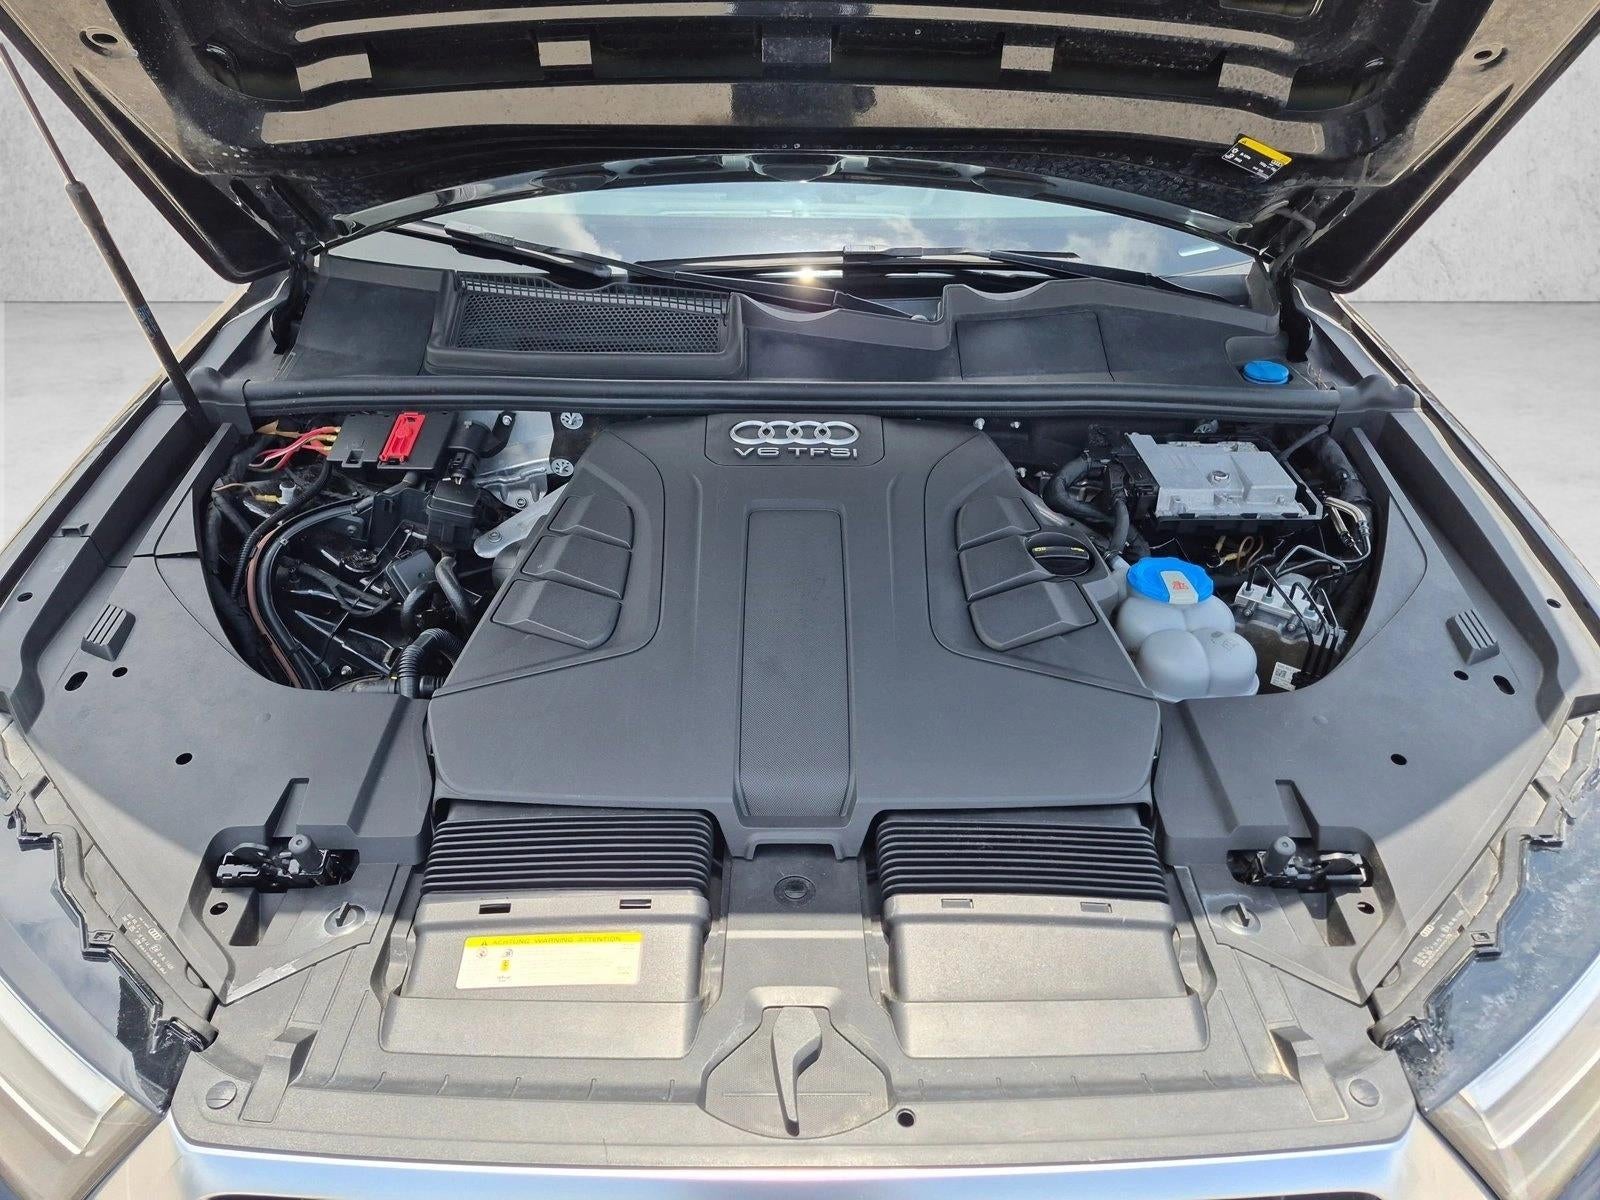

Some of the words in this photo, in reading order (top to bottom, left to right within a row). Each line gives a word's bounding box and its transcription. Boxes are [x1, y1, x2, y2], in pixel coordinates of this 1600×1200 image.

[734, 447, 780, 458] V6
[787, 447, 858, 458] TFSI
[492, 937, 530, 945] ACHTUNG
[534, 936, 574, 944] WARNING
[577, 935, 622, 943] ATTENTION
